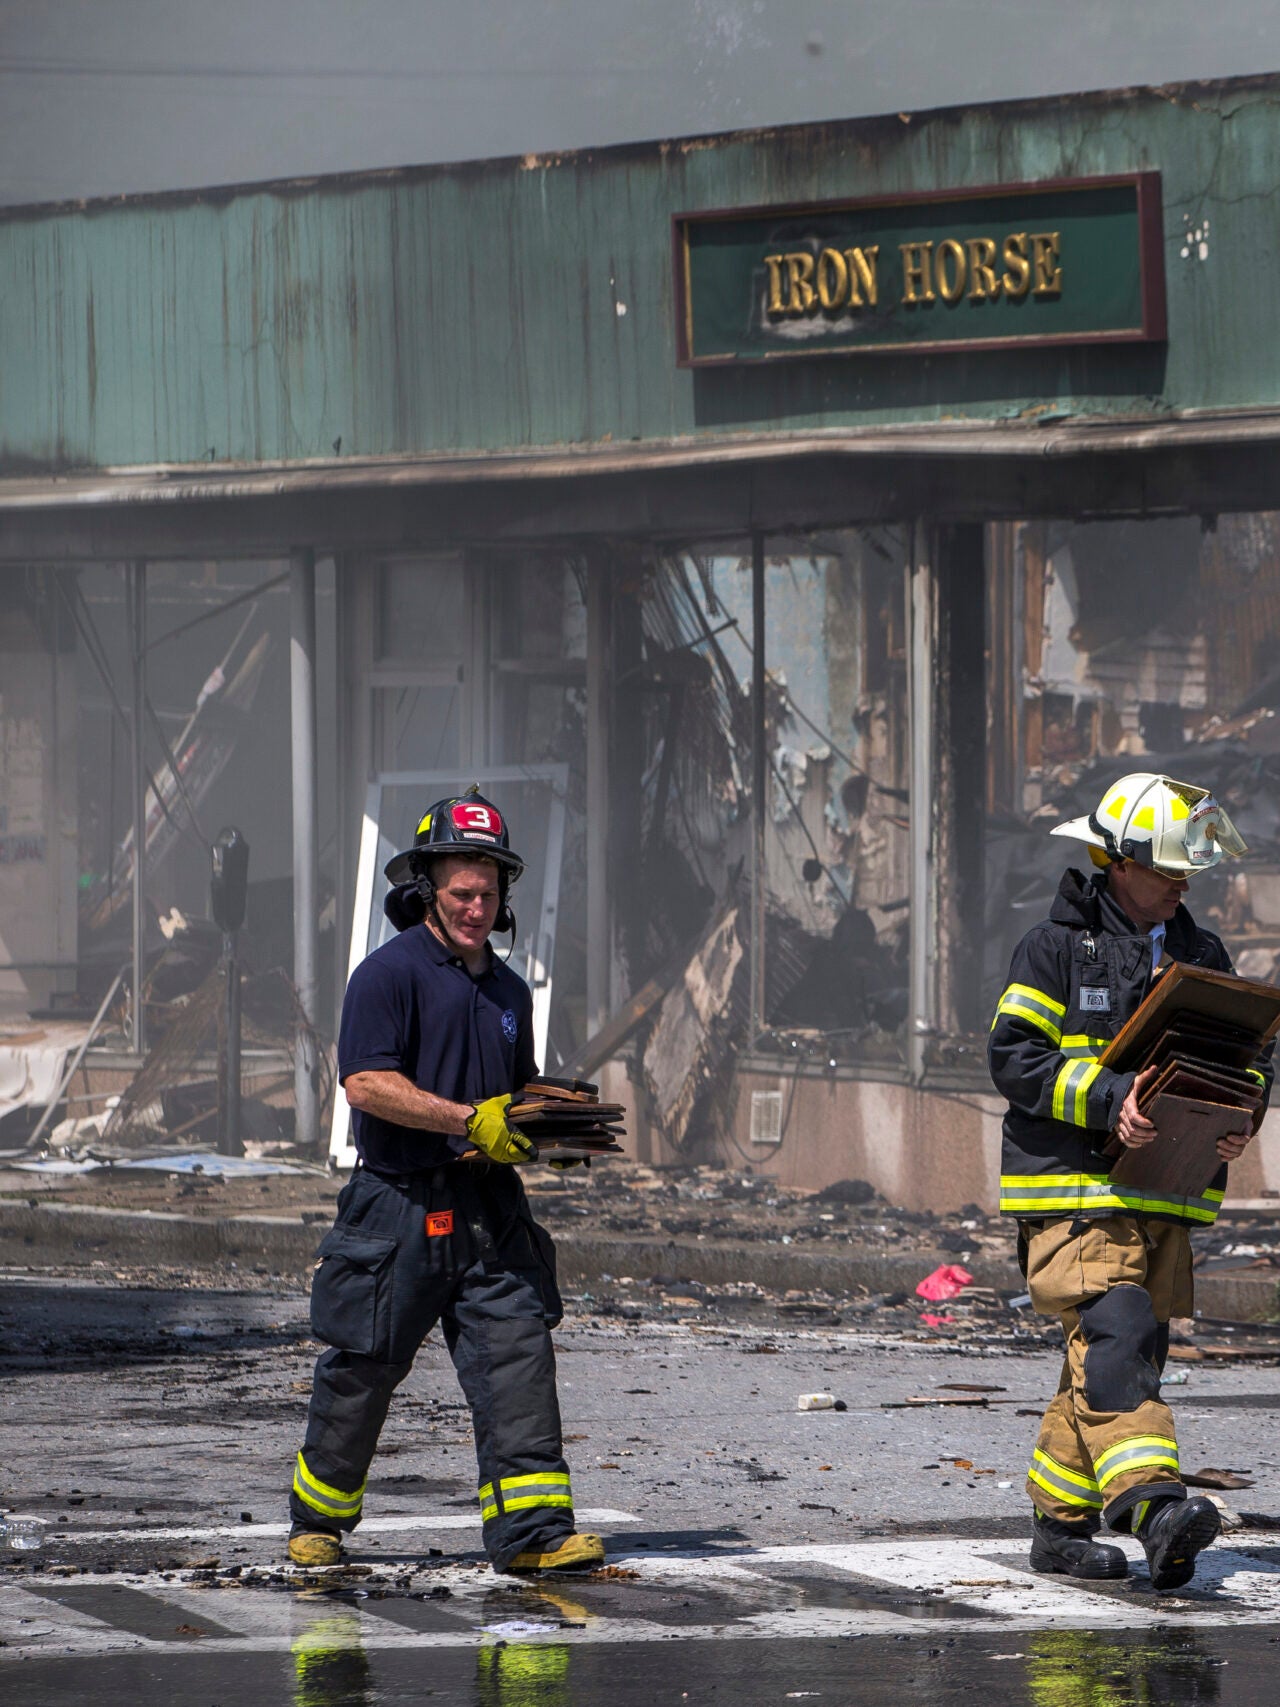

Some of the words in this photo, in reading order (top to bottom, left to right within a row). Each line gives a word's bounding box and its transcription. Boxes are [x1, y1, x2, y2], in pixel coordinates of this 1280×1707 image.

[764, 245, 879, 313] IRON
[898, 231, 1062, 304] HORSE
[465, 806, 491, 828] 3
